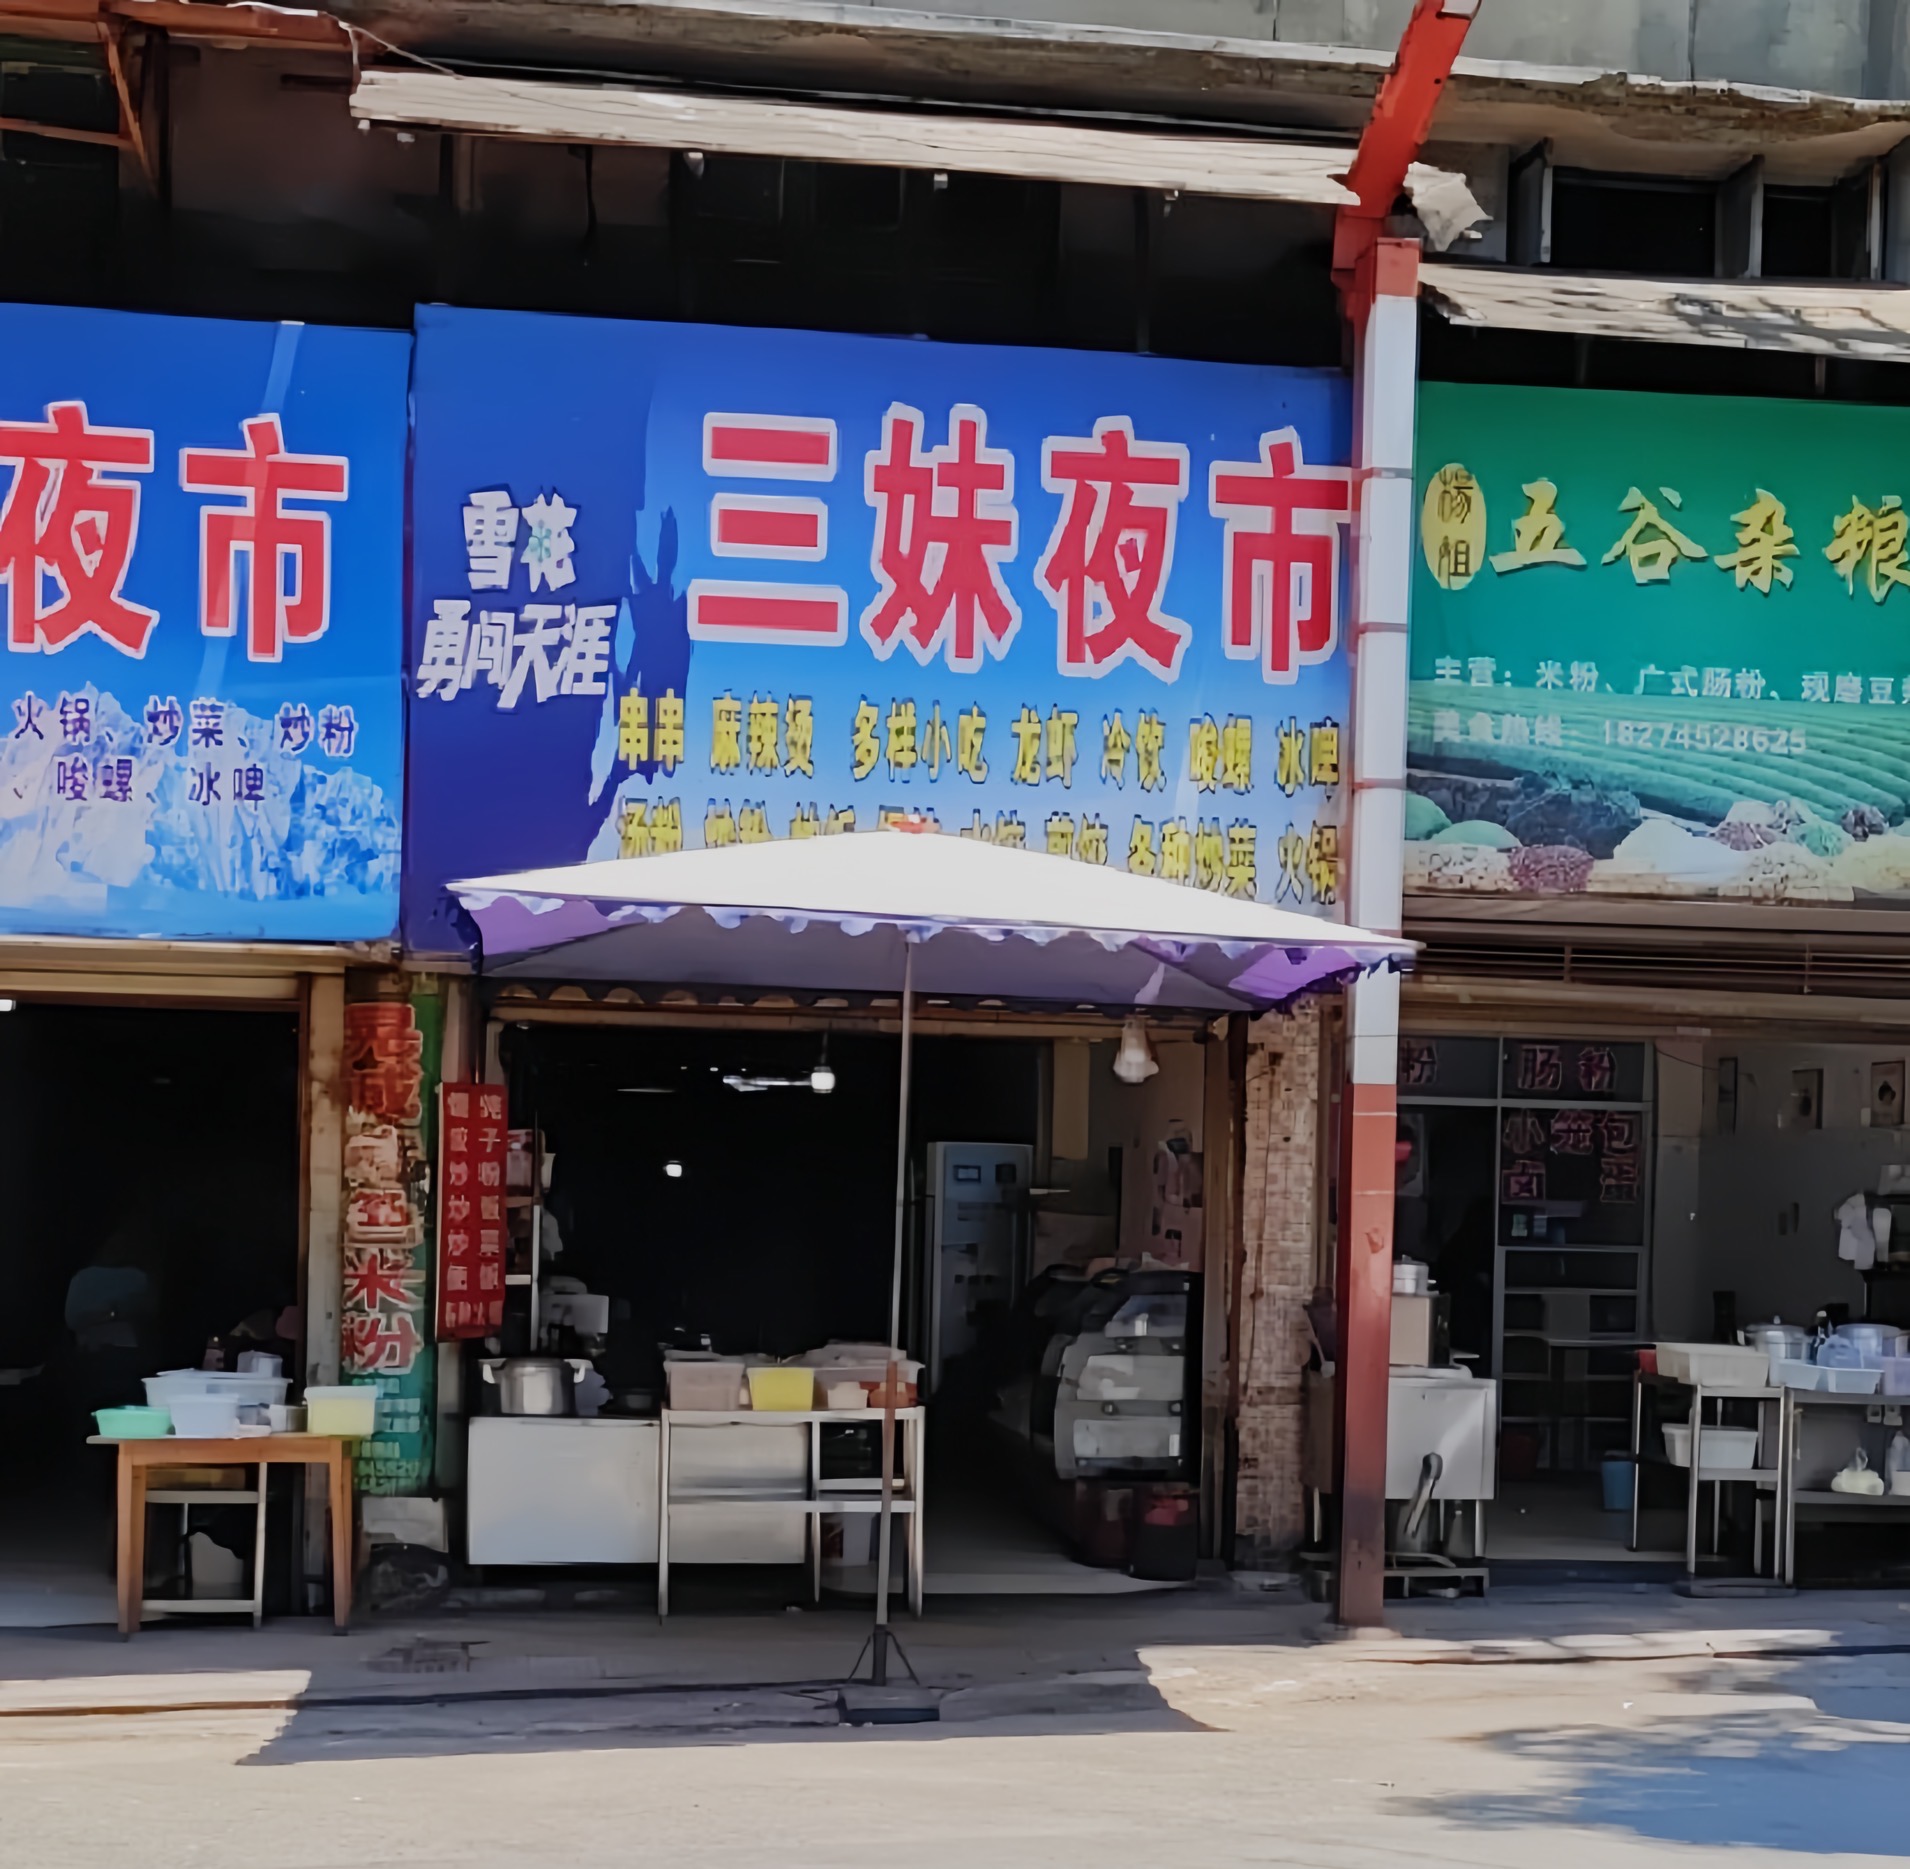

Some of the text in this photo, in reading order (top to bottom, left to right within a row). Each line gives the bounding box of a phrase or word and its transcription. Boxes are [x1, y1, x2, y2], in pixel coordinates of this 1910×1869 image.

[0, 401, 349, 662] 夜市
[462, 489, 577, 593] 雪花
[687, 402, 1352, 685] 三妹夜市
[1489, 477, 1910, 604] 五谷杂粮
[416, 600, 617, 708] 勇闯天涯
[618, 688, 685, 770] 串串
[710, 689, 815, 779] 麻辣烫
[851, 694, 989, 783] 多样小吃
[1010, 702, 1079, 789] 龙虾
